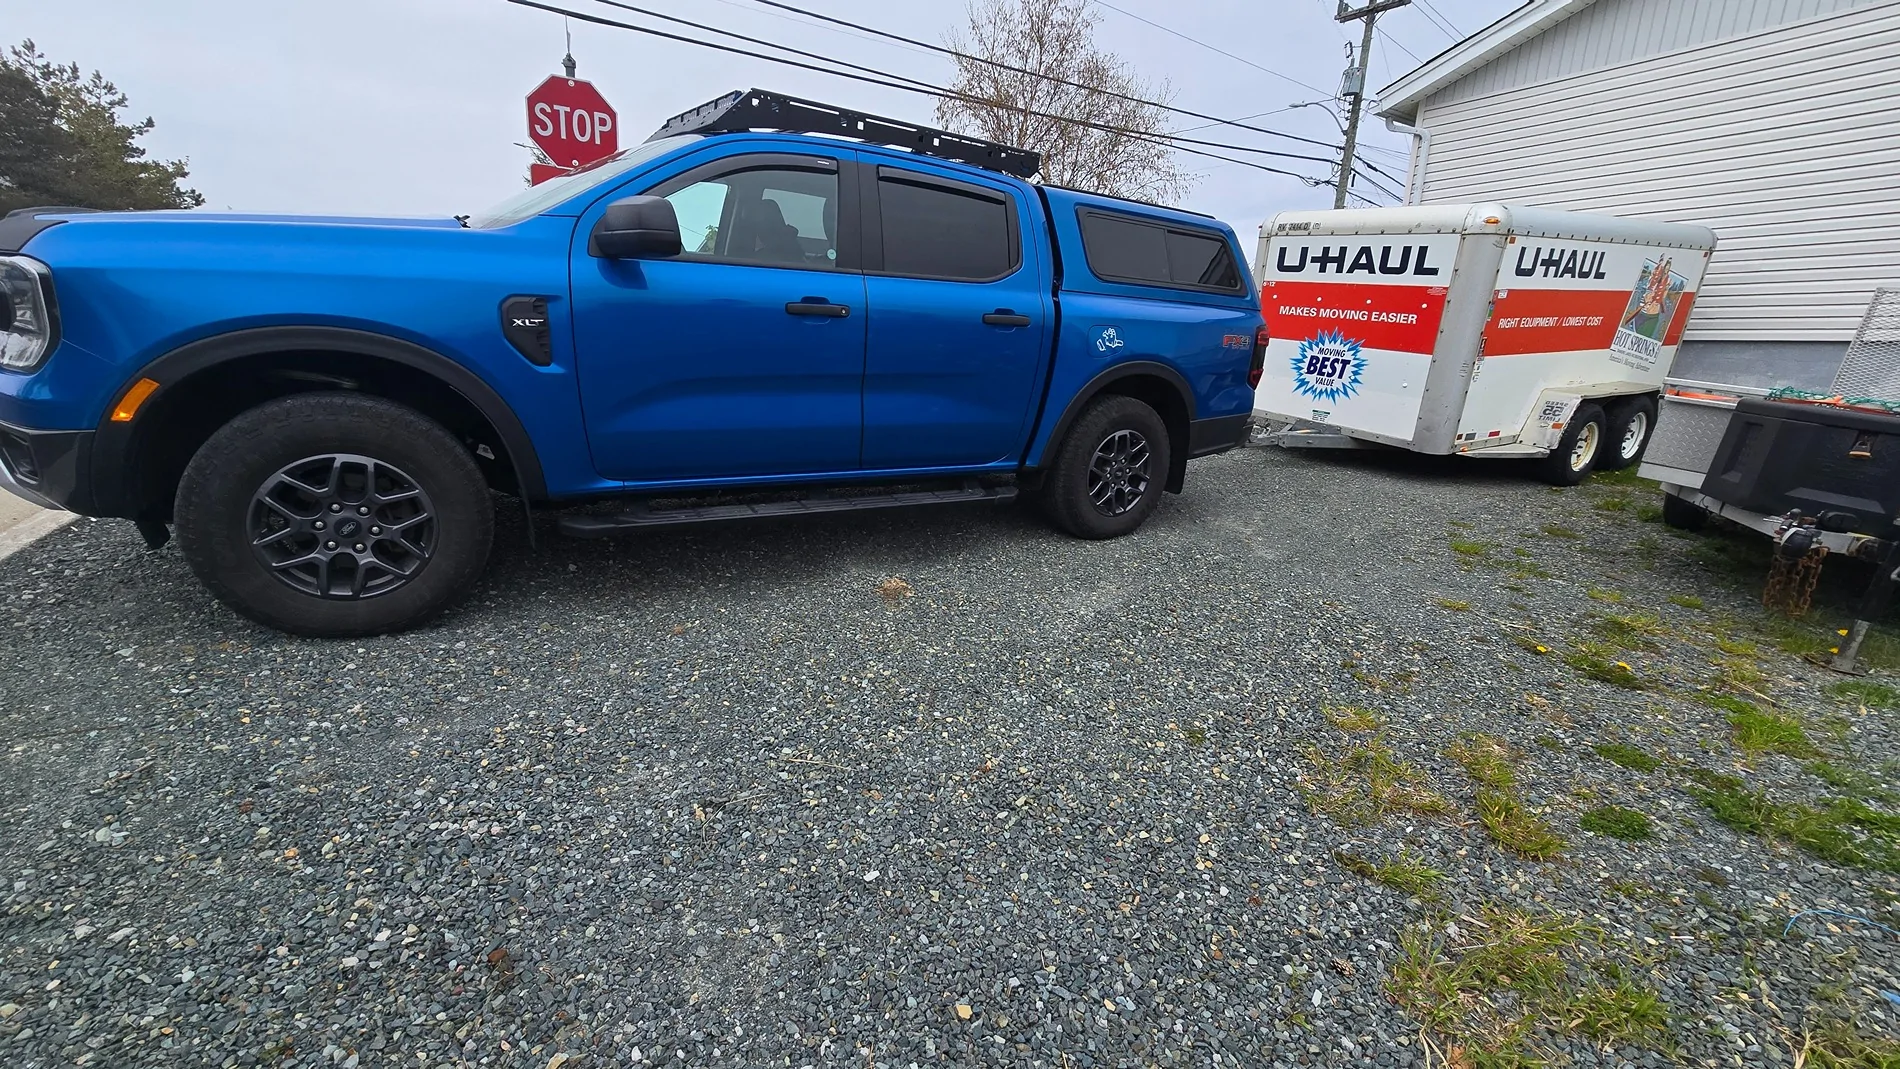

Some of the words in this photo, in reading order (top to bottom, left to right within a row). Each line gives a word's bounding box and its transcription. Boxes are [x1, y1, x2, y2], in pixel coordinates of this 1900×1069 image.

[534, 102, 612, 145] STOP
[1276, 245, 1440, 276] U-HAUL
[1514, 246, 1607, 280] U-HAUL
[511, 318, 545, 327] XLT
[1279, 305, 1317, 317] MAKES
[1319, 308, 1369, 321] MOVING
[1371, 311, 1418, 325] EASIER
[1497, 317, 1521, 329] RIGHT
[1520, 316, 1558, 328] EQUIPMENT
[1562, 316, 1587, 327] LOWEST
[1586, 316, 1604, 326] COST
[1223, 334, 1251, 348] FX4
[1613, 329, 1631, 348] HOT
[1627, 335, 1658, 358] SPRINGS
[1317, 347, 1346, 358] MOVING
[1305, 355, 1352, 380] BEST
[1315, 377, 1335, 387] VALUE
